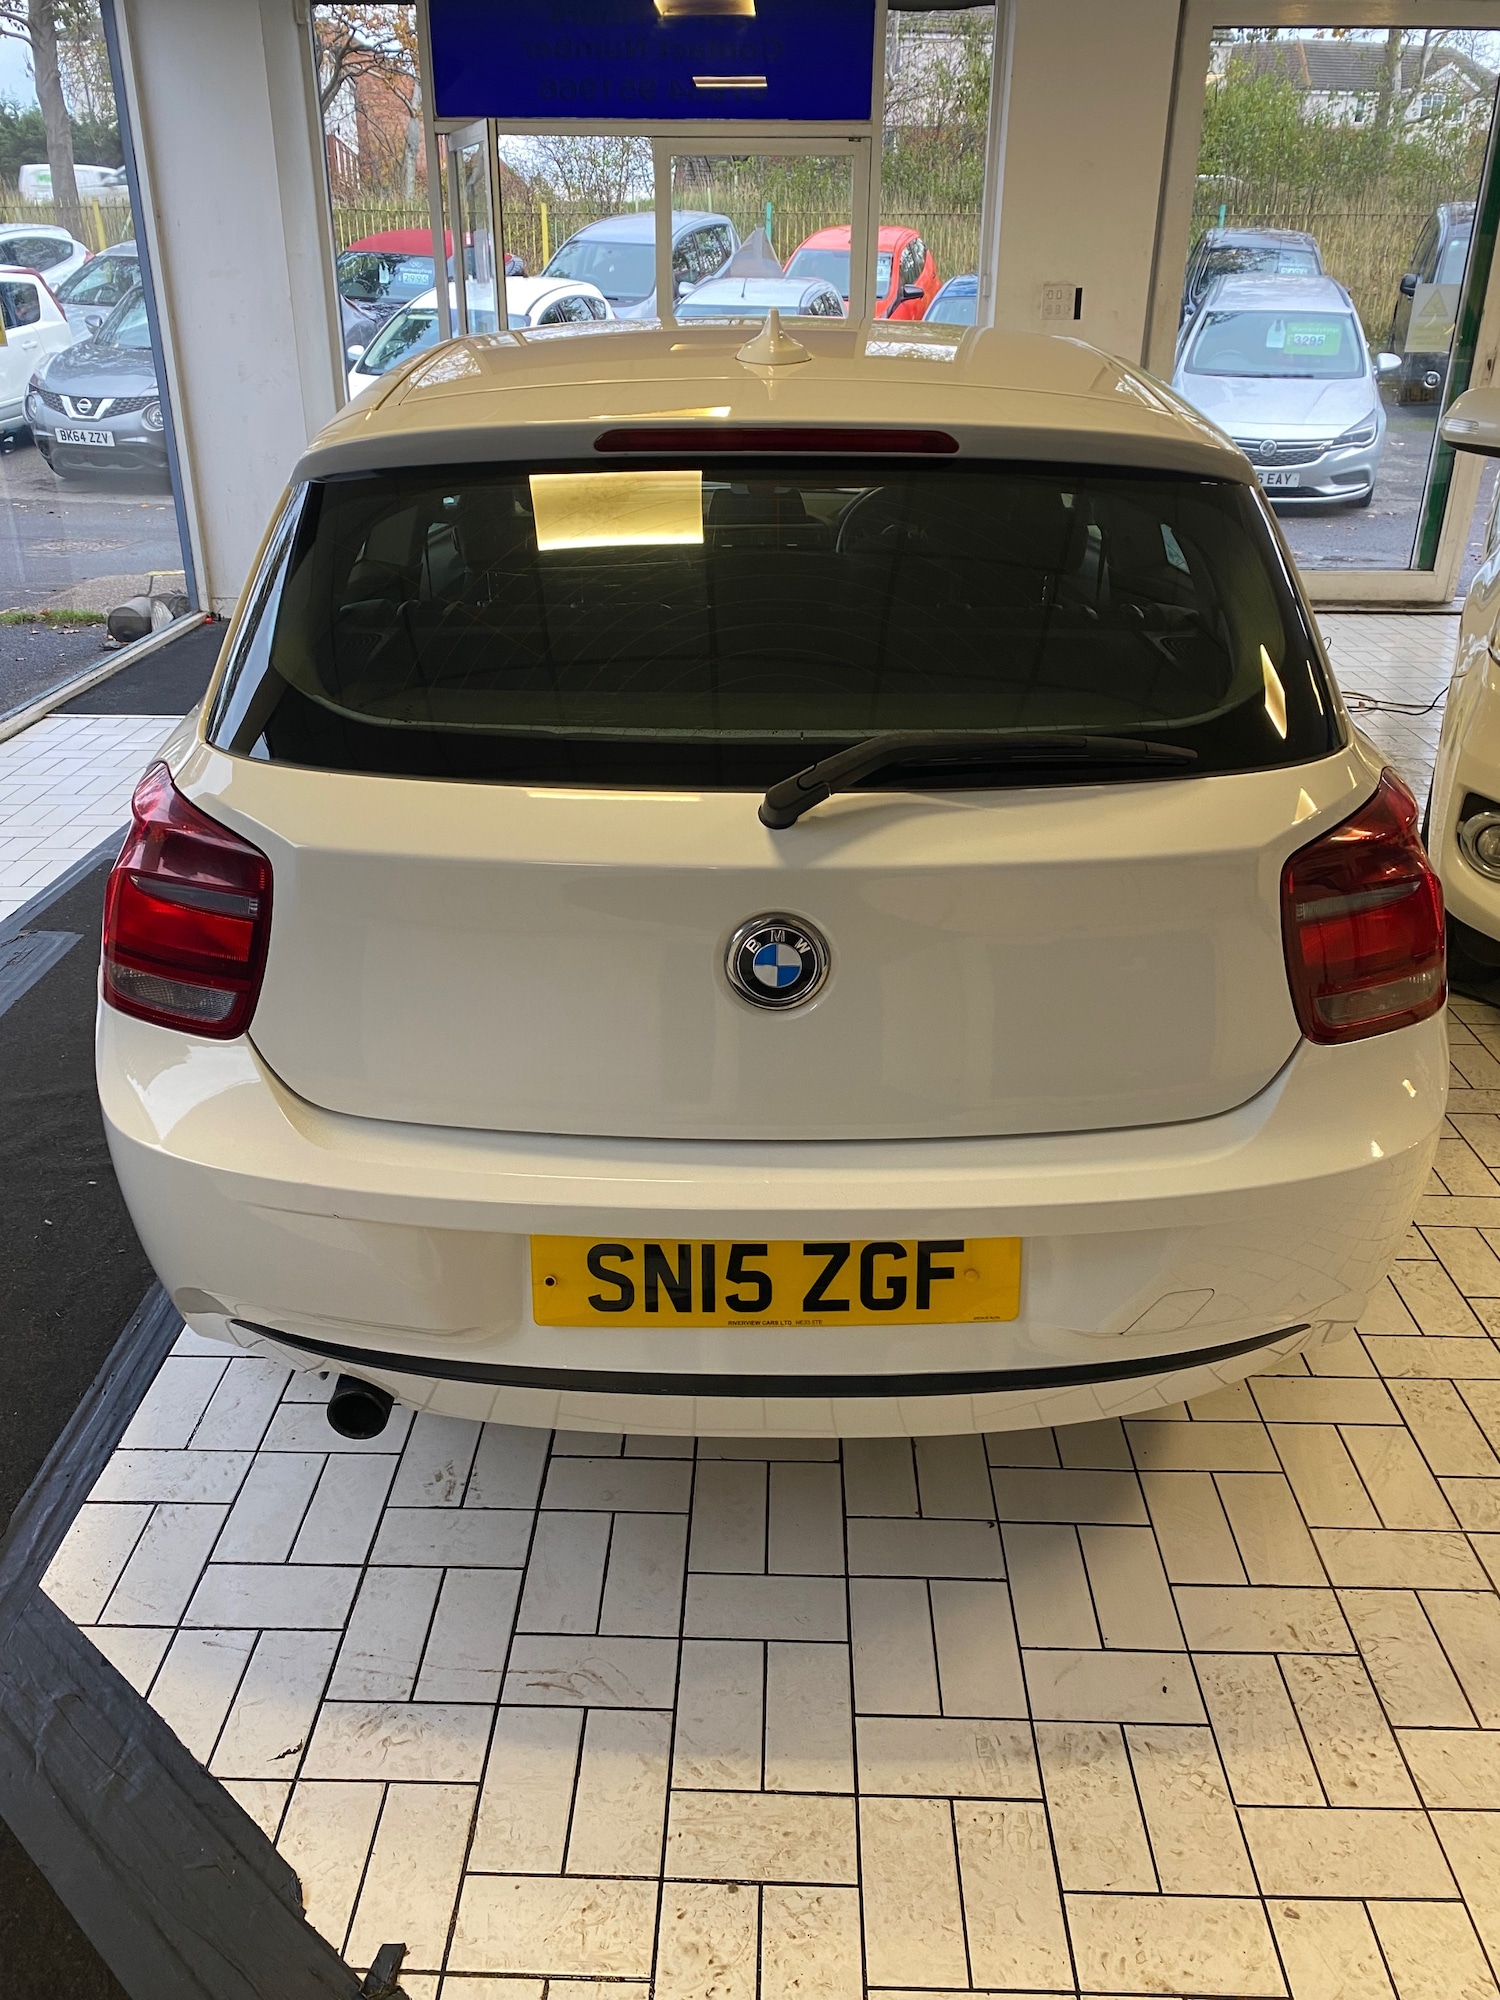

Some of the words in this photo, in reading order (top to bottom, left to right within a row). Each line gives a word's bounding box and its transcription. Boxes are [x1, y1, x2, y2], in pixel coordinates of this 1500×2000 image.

[60, 429, 87, 442] BK64
[88, 431, 108, 444] ZZV
[1267, 473, 1293, 485] EAY
[745, 929, 811, 954] BMW
[586, 1241, 773, 1314] SN15
[802, 1239, 965, 1312] ZGF
